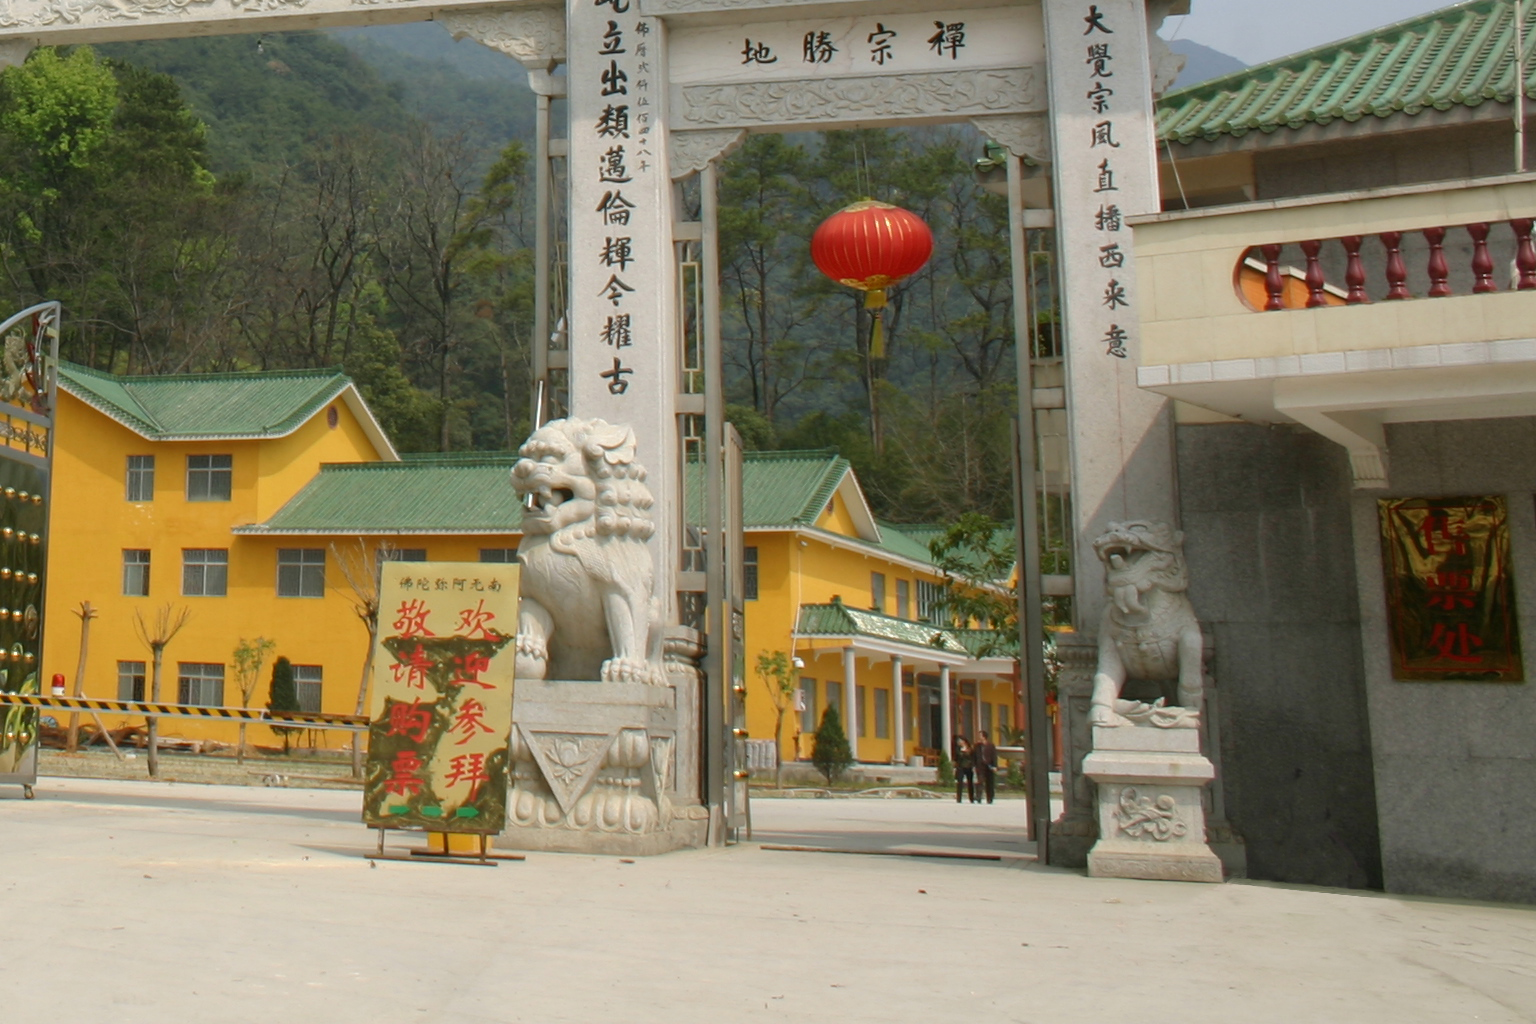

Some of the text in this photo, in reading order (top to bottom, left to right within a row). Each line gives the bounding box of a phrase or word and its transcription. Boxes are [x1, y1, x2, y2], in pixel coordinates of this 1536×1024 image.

[740, 20, 966, 66] 禪宗勝地
[1417, 510, 1484, 664] 售票处
[383, 598, 436, 797] 敬请购票
[443, 598, 501, 802] 欢迎参拜
